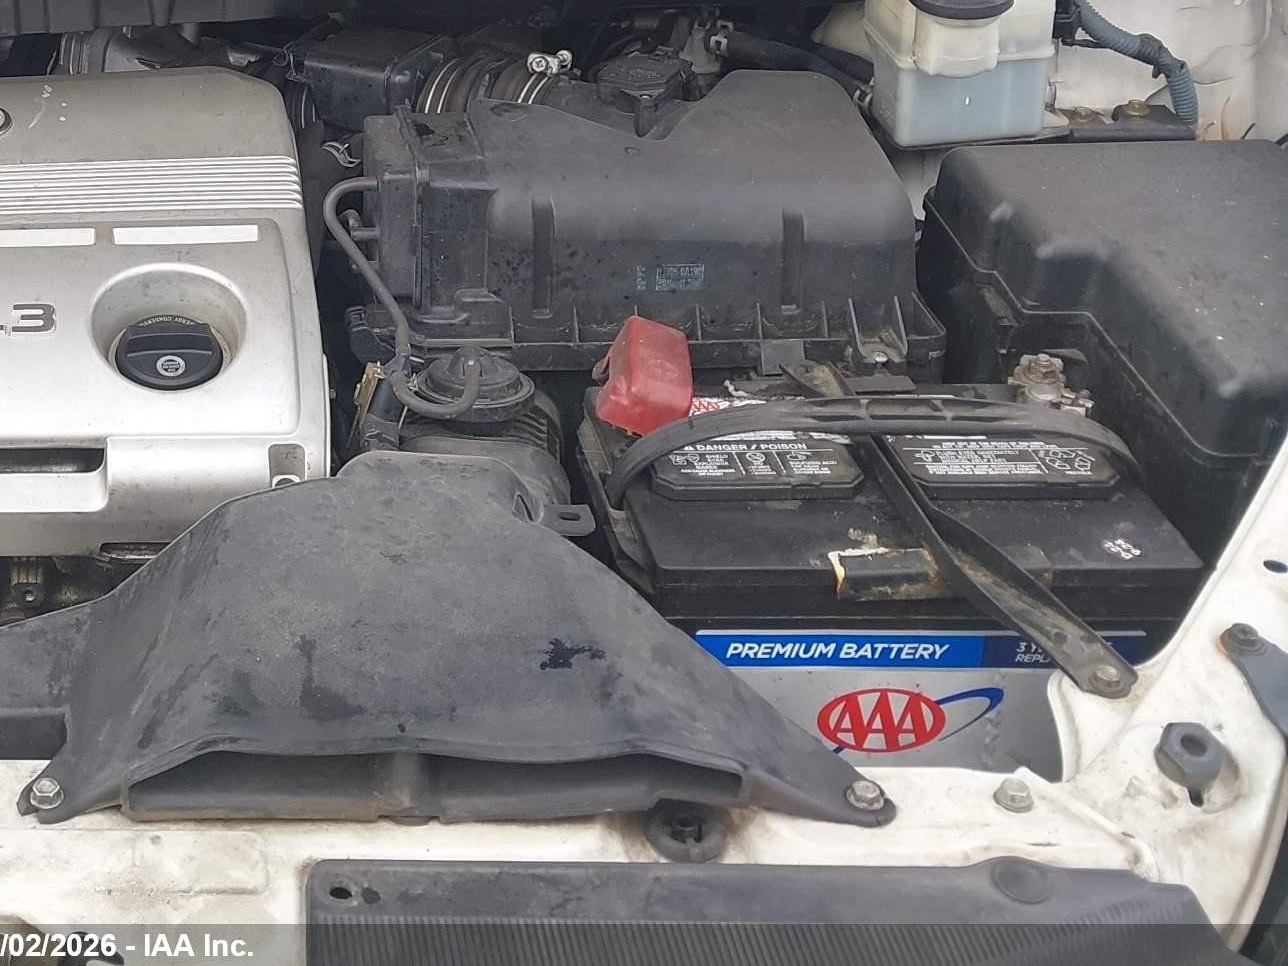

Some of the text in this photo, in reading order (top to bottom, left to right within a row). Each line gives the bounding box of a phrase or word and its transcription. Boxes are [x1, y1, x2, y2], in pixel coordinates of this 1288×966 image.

[725, 642, 951, 660] PREMIUM BATTERY
[824, 689, 934, 751] AAA
